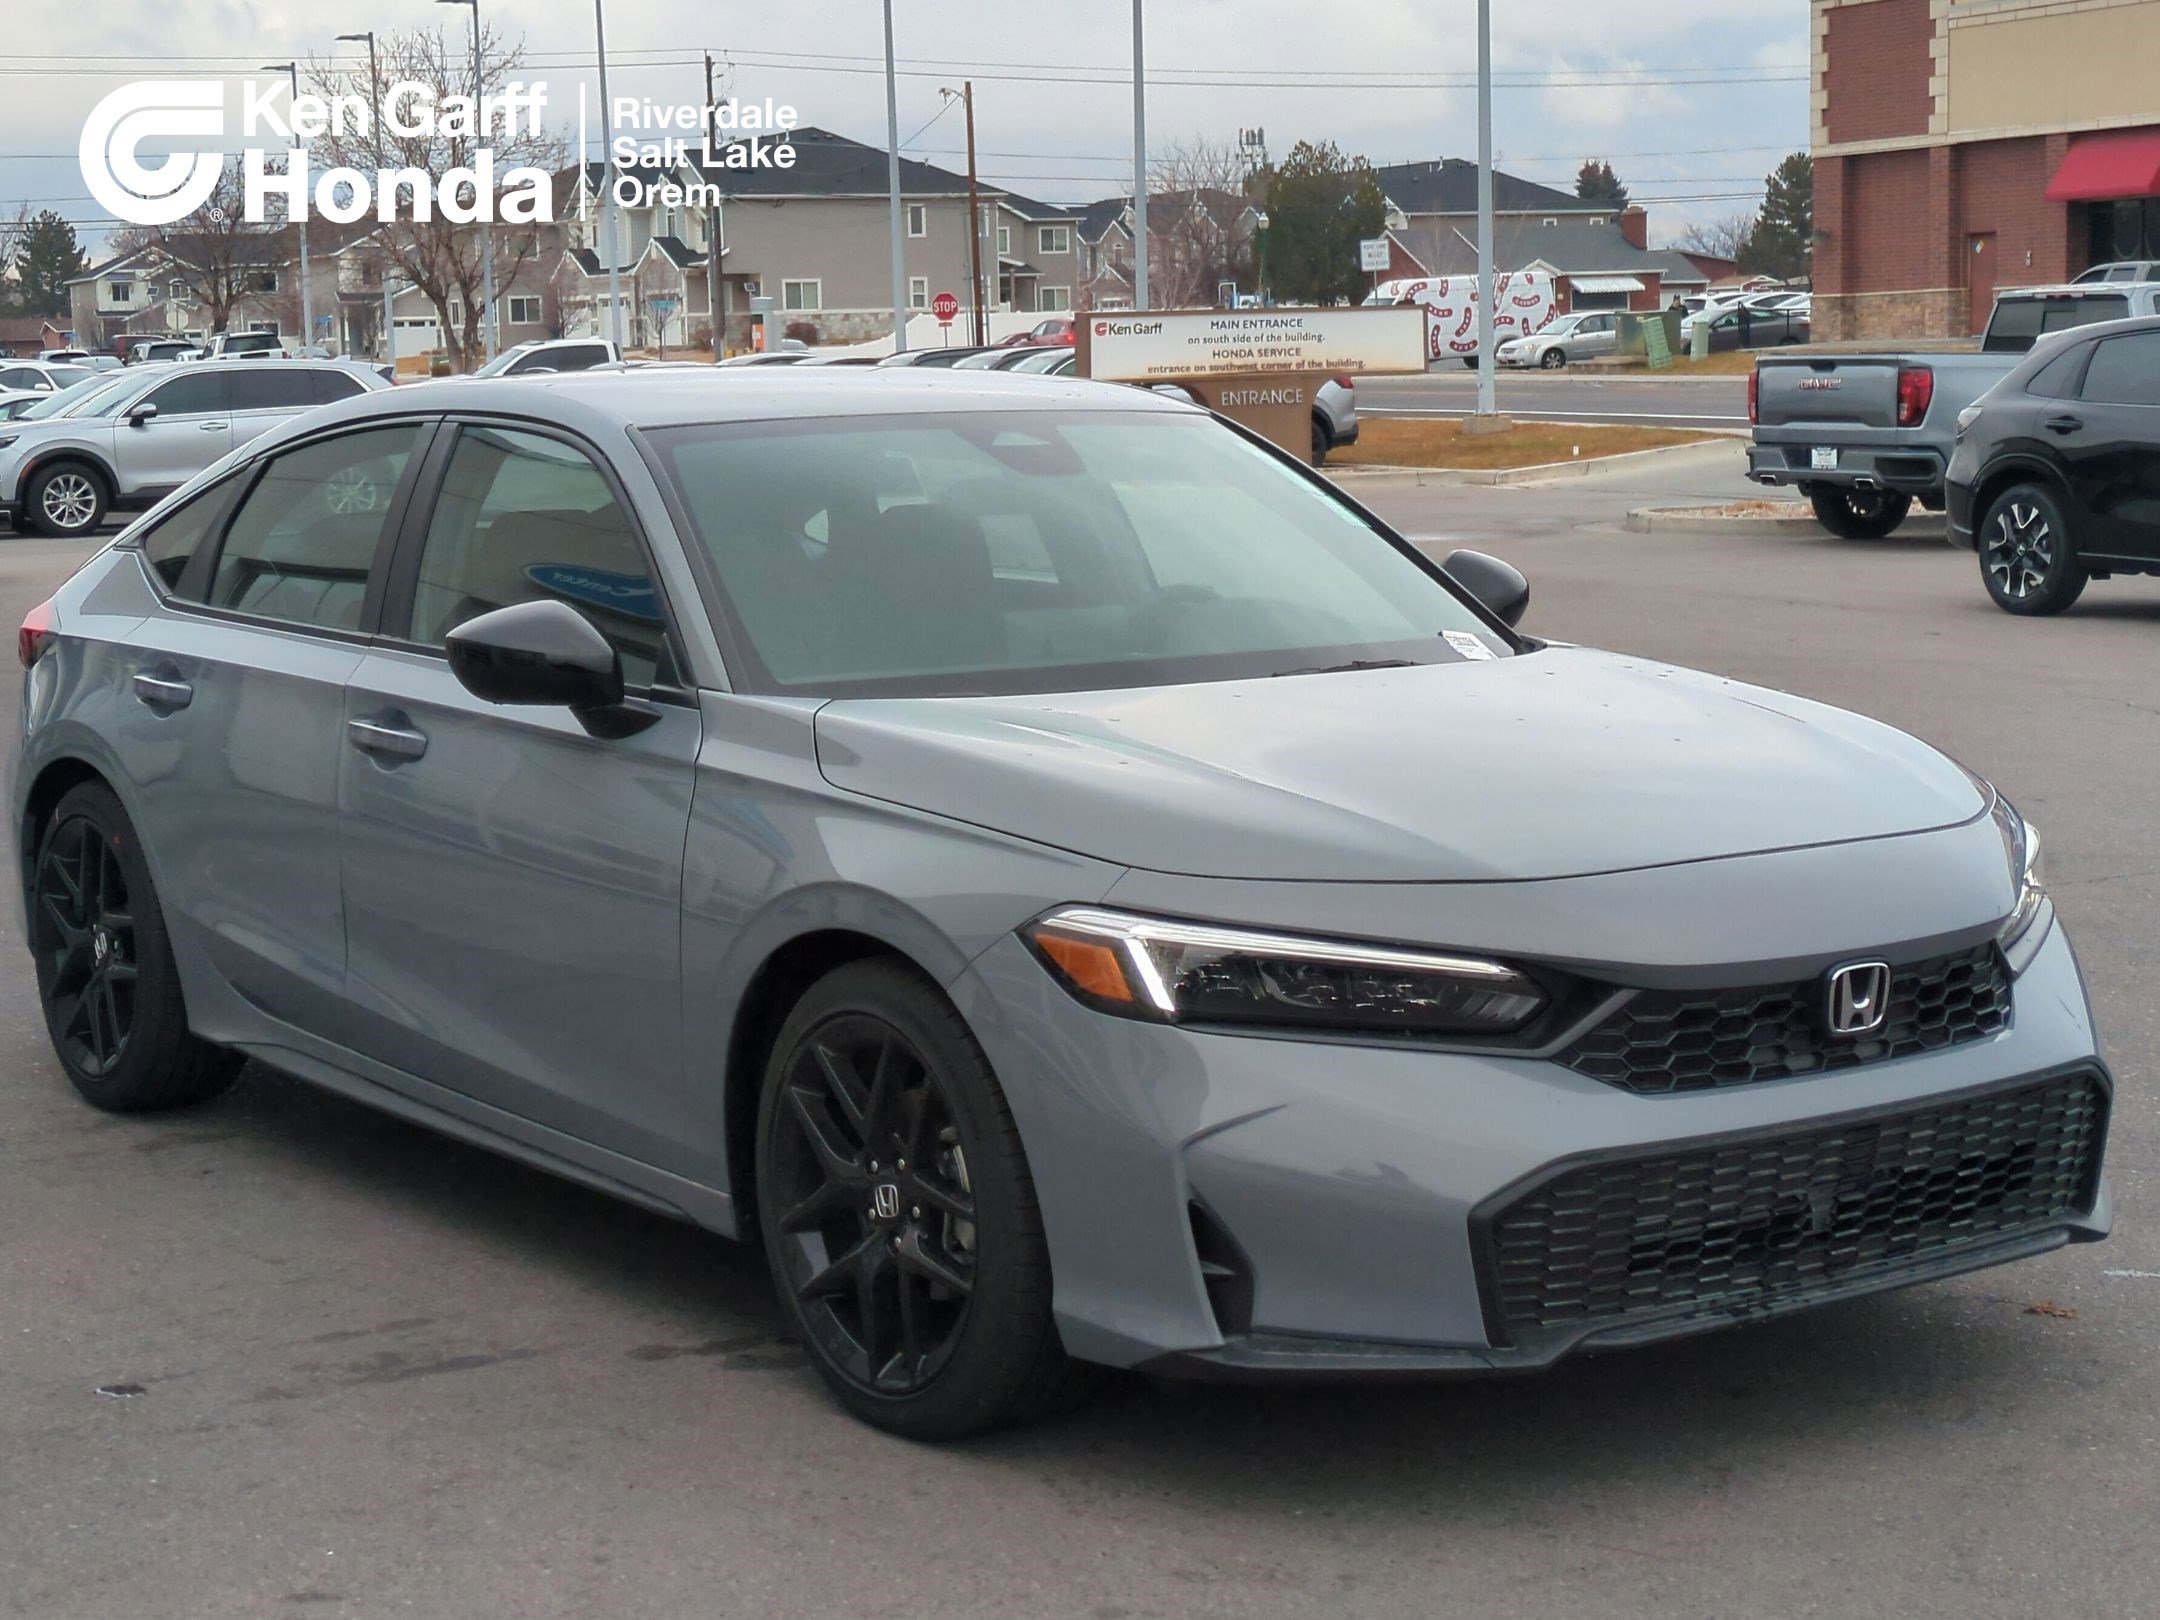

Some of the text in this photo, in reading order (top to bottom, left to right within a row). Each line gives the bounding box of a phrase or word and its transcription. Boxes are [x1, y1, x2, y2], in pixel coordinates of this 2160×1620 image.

[933, 301, 957, 313] STOP
[1108, 322, 1163, 336] Ken Garff
[1210, 318, 1304, 330] MAIN ENTRANCE
[1187, 333, 1326, 345] on south side of the building.
[1212, 347, 1302, 359] HONDA SERVICE
[1147, 359, 1367, 374] entrance on southwest corner of the building.
[1799, 377, 1842, 391] GMC
[1221, 388, 1304, 406] ENTRANCE
